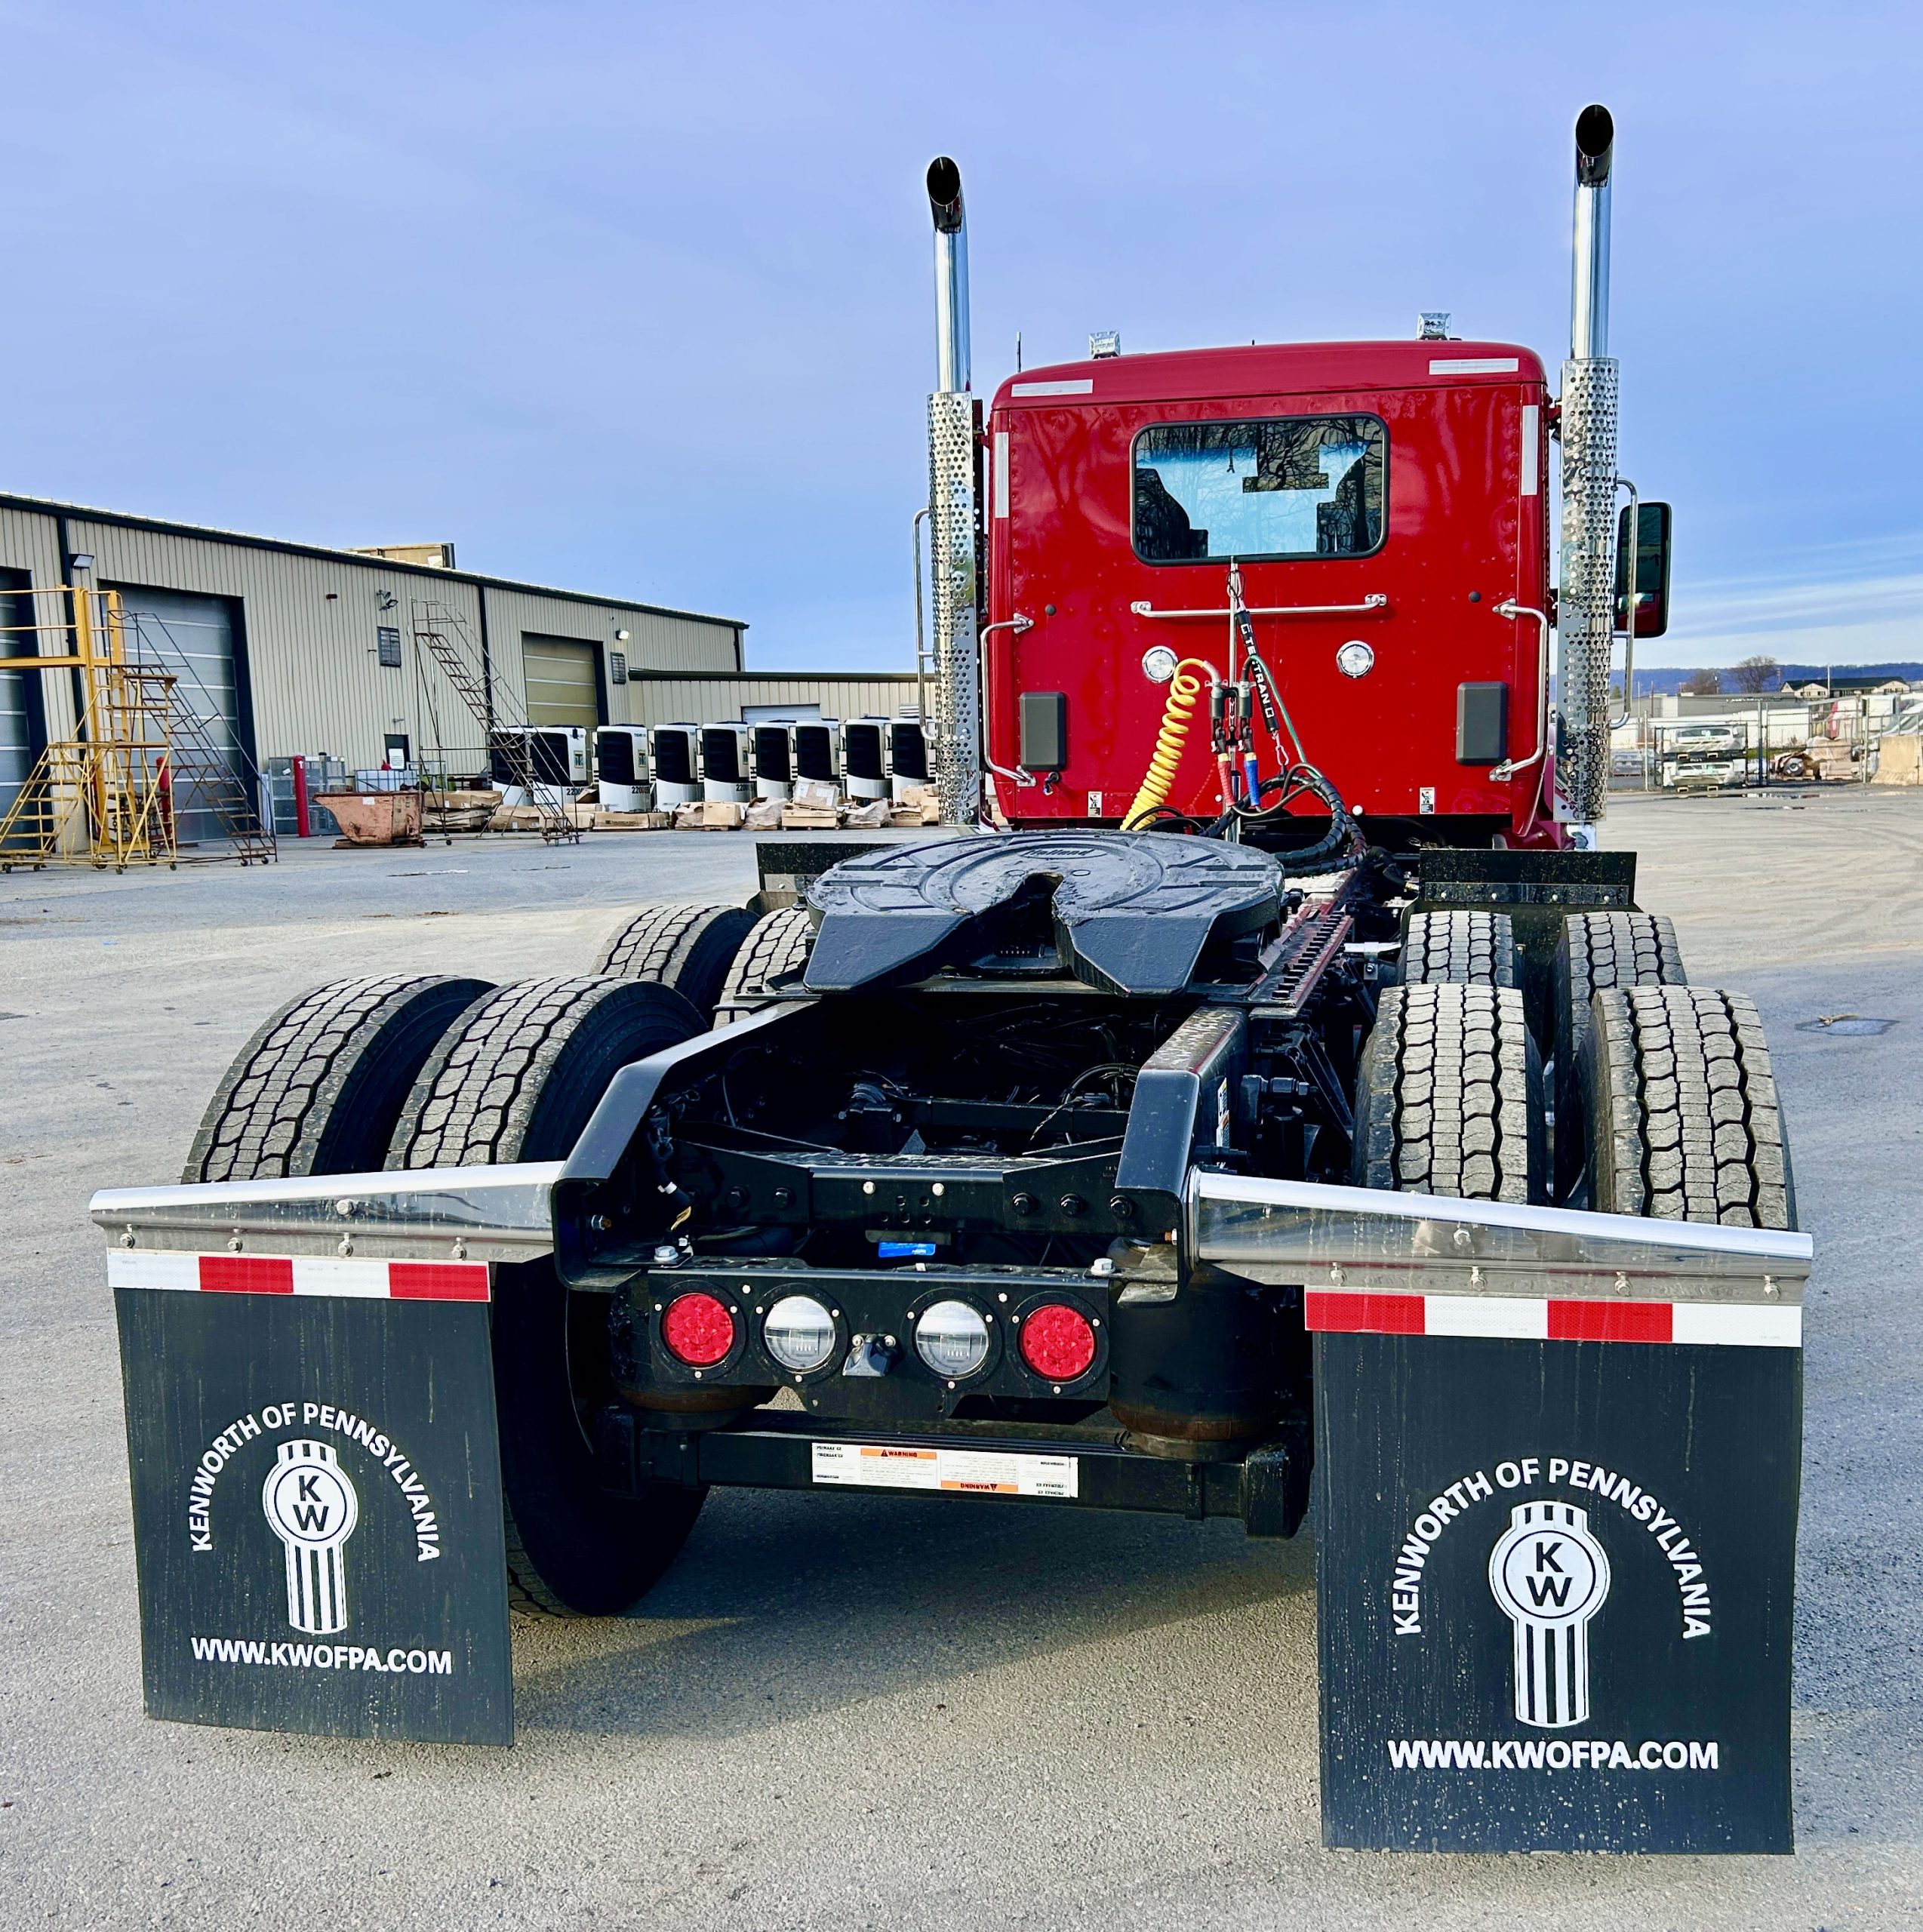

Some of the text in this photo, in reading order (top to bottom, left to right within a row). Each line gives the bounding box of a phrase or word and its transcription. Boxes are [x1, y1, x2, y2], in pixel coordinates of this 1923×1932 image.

[189, 1402, 441, 1562] KENWORTH OF PENNSYLVANIA
[960, 1482, 990, 1491] WARNING
[1392, 1458, 1712, 1640] KENWORTH OF PENNSYLVANIA
[190, 1636, 453, 1675] WWW.KWOFPA.COM
[1387, 1740, 1719, 1770] WWW.KWOFPA.COM
